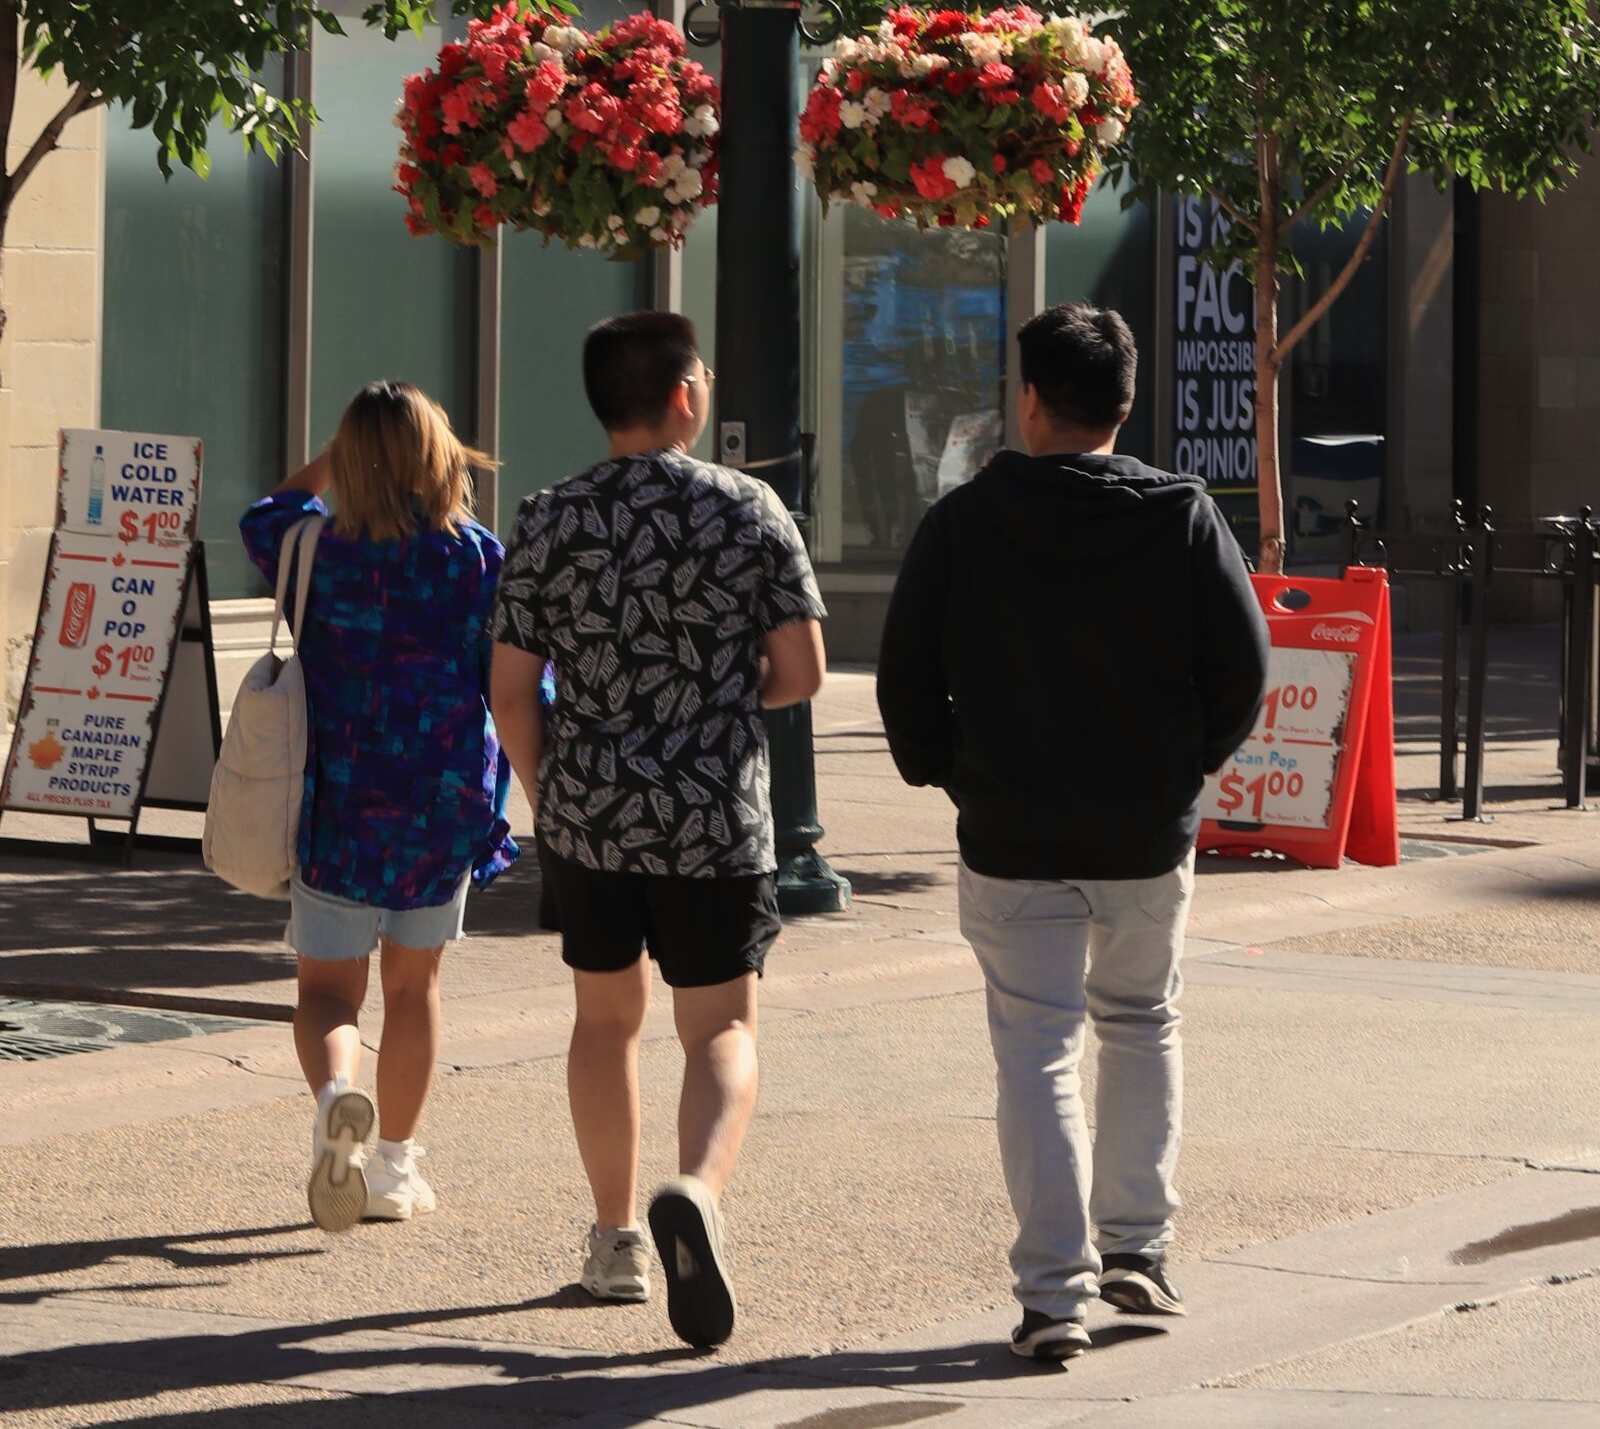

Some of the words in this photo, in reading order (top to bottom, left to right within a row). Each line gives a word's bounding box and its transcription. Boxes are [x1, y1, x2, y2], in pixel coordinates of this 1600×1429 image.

[1178, 192, 1202, 248] IS
[1178, 255, 1257, 333] FAC
[1178, 379, 1200, 431] IS
[1206, 379, 1257, 431] JUS
[133, 442, 168, 460] ICE
[121, 463, 177, 483] COLD
[111, 485, 185, 507] WATER
[112, 576, 155, 596] CAN
[122, 599, 137, 616] O
[104, 619, 146, 639] POP
[84, 714, 126, 730] PURE
[61, 728, 141, 748] CANADIAN
[71, 746, 123, 763] MAPLE
[1234, 747, 1263, 765] Can
[1269, 751, 1297, 771] Pop
[68, 762, 119, 778] SYRUP
[49, 776, 131, 796] PRODUCTS
